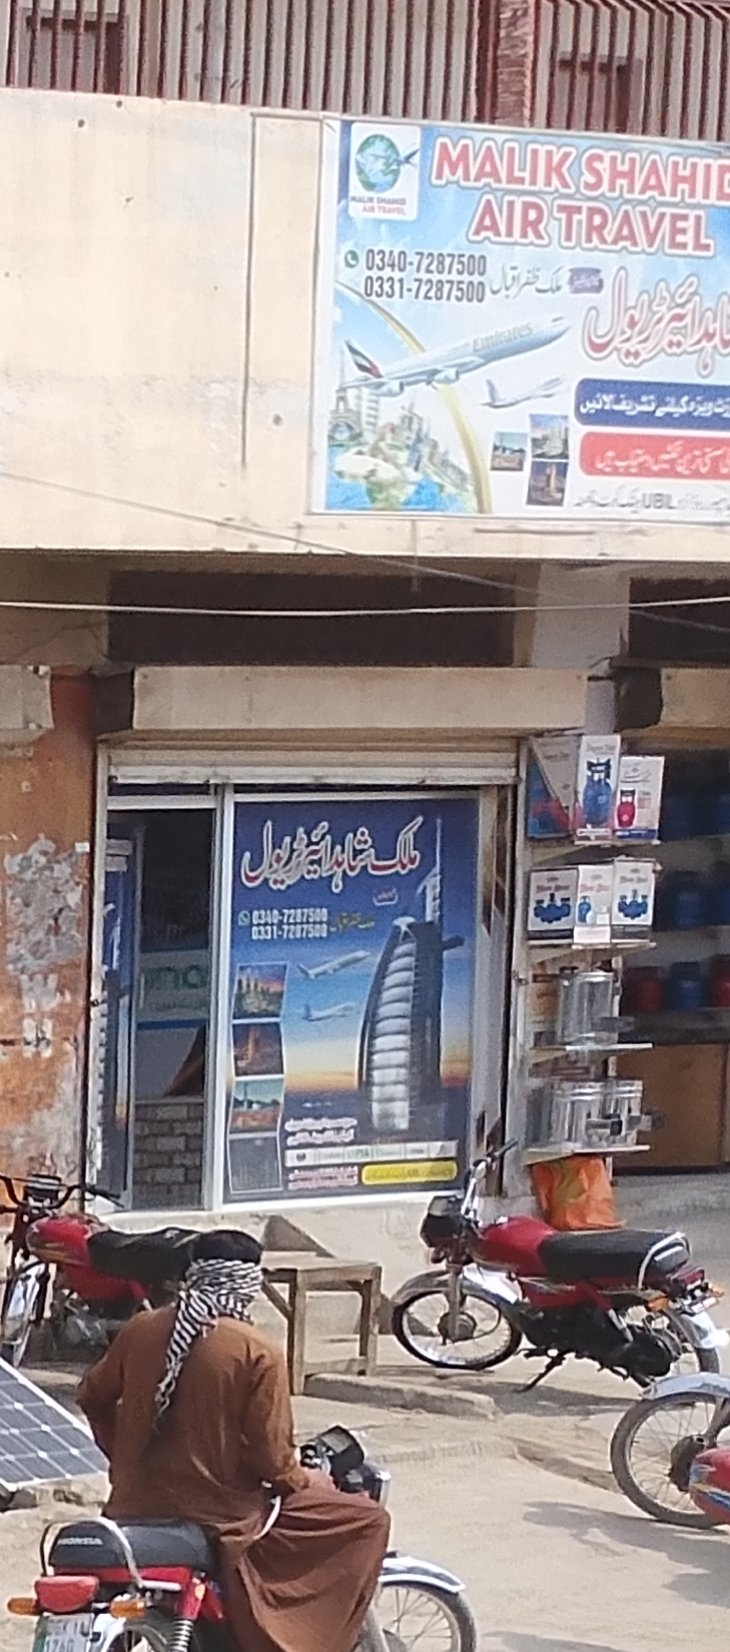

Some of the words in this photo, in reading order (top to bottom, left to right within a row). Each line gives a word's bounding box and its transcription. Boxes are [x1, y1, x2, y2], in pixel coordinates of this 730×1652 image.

[433, 139, 576, 191] MALIK
[470, 196, 547, 242] AIR
[554, 202, 714, 253] TRAVEL
[365, 248, 487, 277] 0340-7287500
[364, 275, 486, 303] 0331-7287500
[641, 493, 679, 510] UBL
[368, 815, 424, 876] ملک
